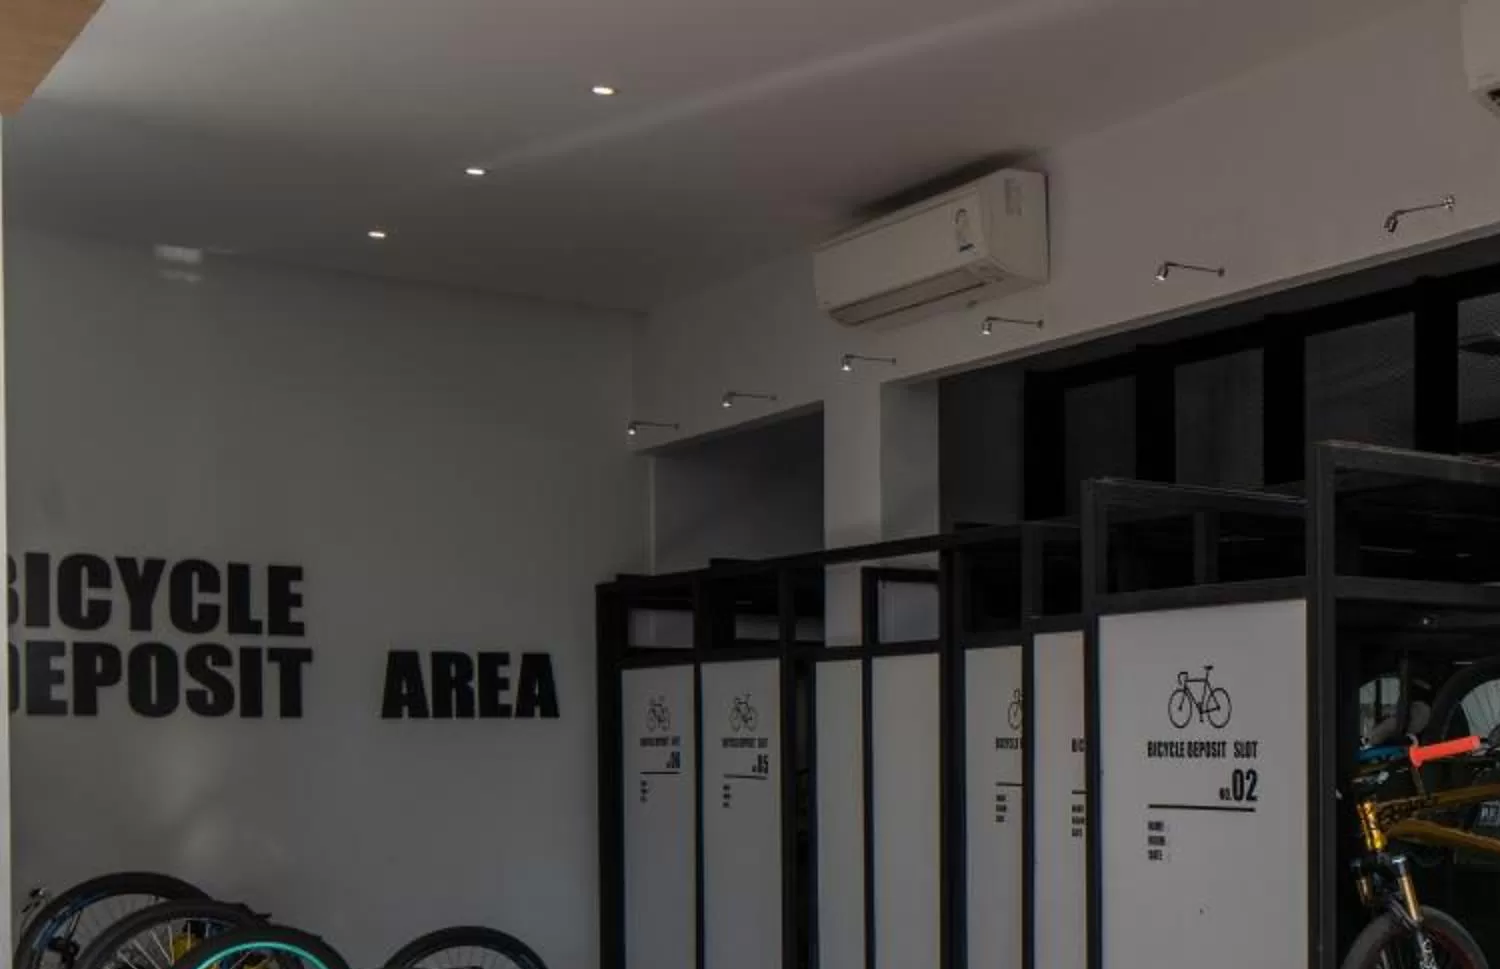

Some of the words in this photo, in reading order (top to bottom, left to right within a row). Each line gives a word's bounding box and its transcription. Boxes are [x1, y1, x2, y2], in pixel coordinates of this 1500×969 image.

[8, 552, 305, 637] ICYCLE
[8, 641, 313, 718] EPOSIT
[380, 649, 561, 719] AREA
[1147, 740, 1185, 758] BICYCLE
[1187, 740, 1227, 758] DEPOSIT
[1233, 740, 1259, 759] SLOT
